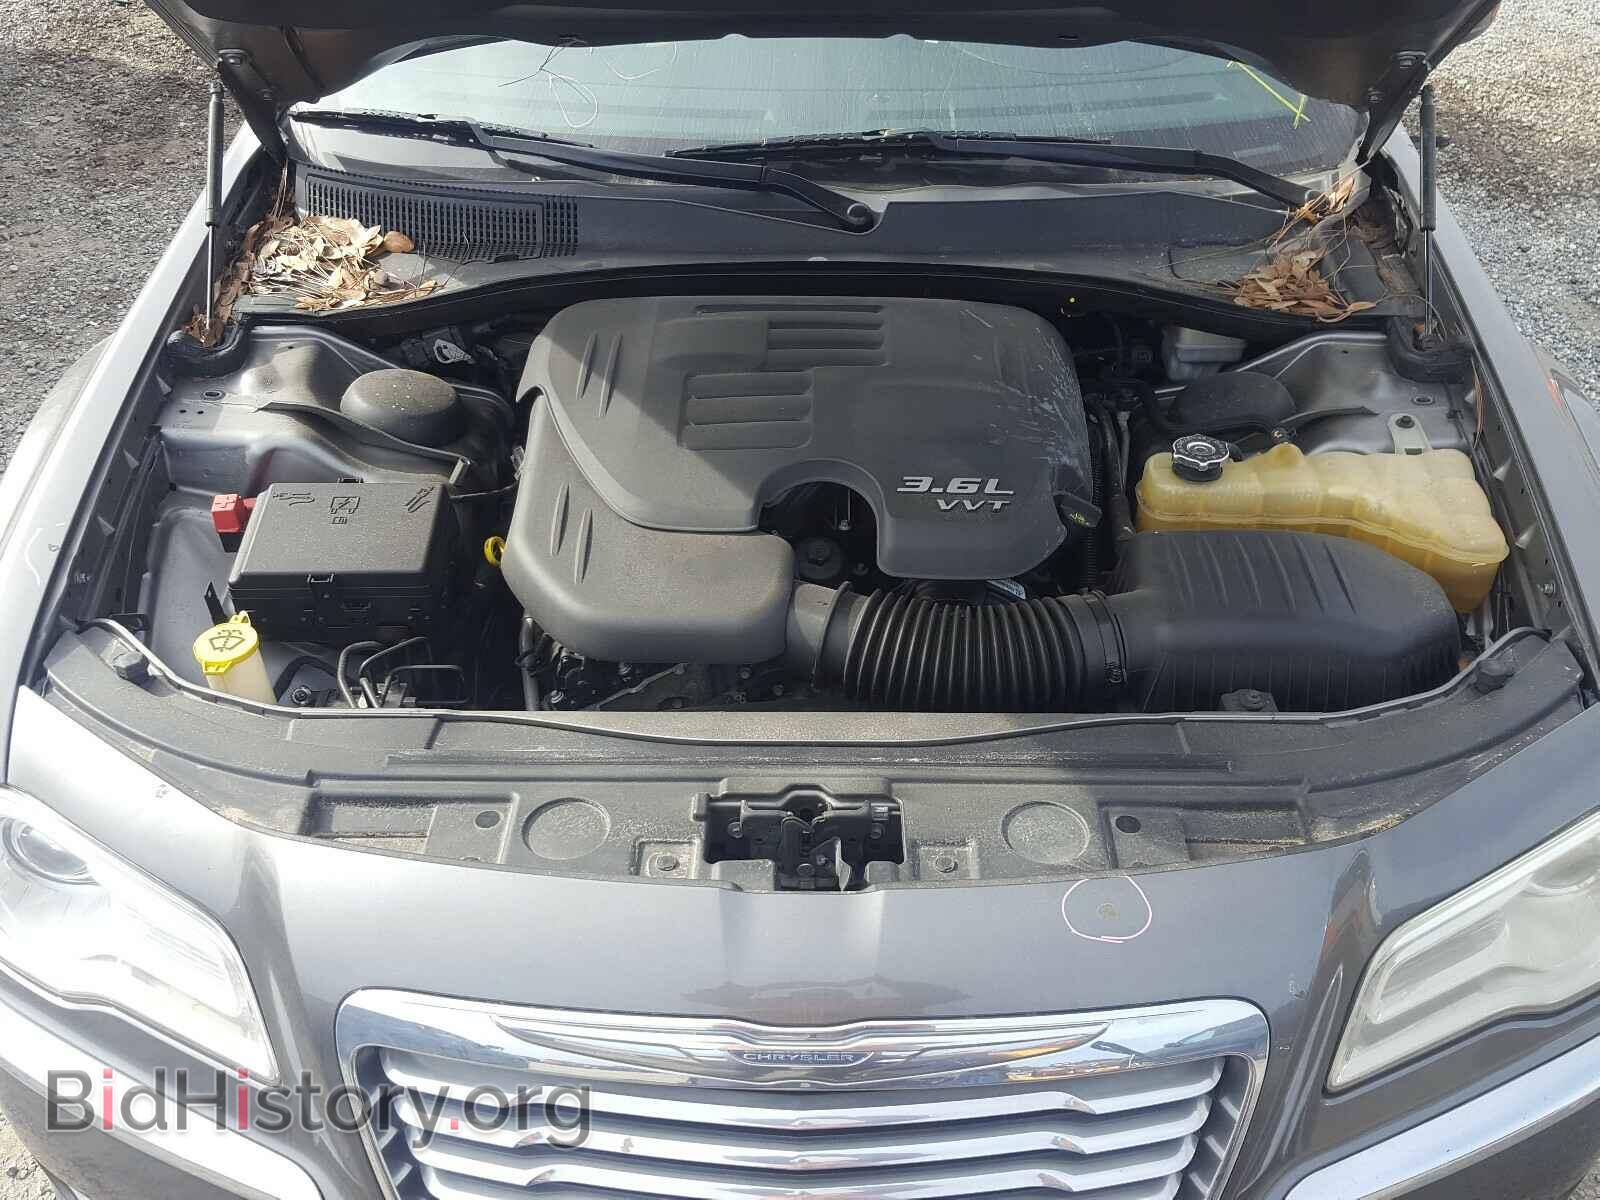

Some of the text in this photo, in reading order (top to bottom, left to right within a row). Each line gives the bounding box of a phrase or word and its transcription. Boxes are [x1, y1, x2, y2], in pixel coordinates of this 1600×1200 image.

[897, 476, 1014, 494] 3.6L
[936, 499, 1011, 511] VVT
[743, 1052, 854, 1062] CHRYSLER
